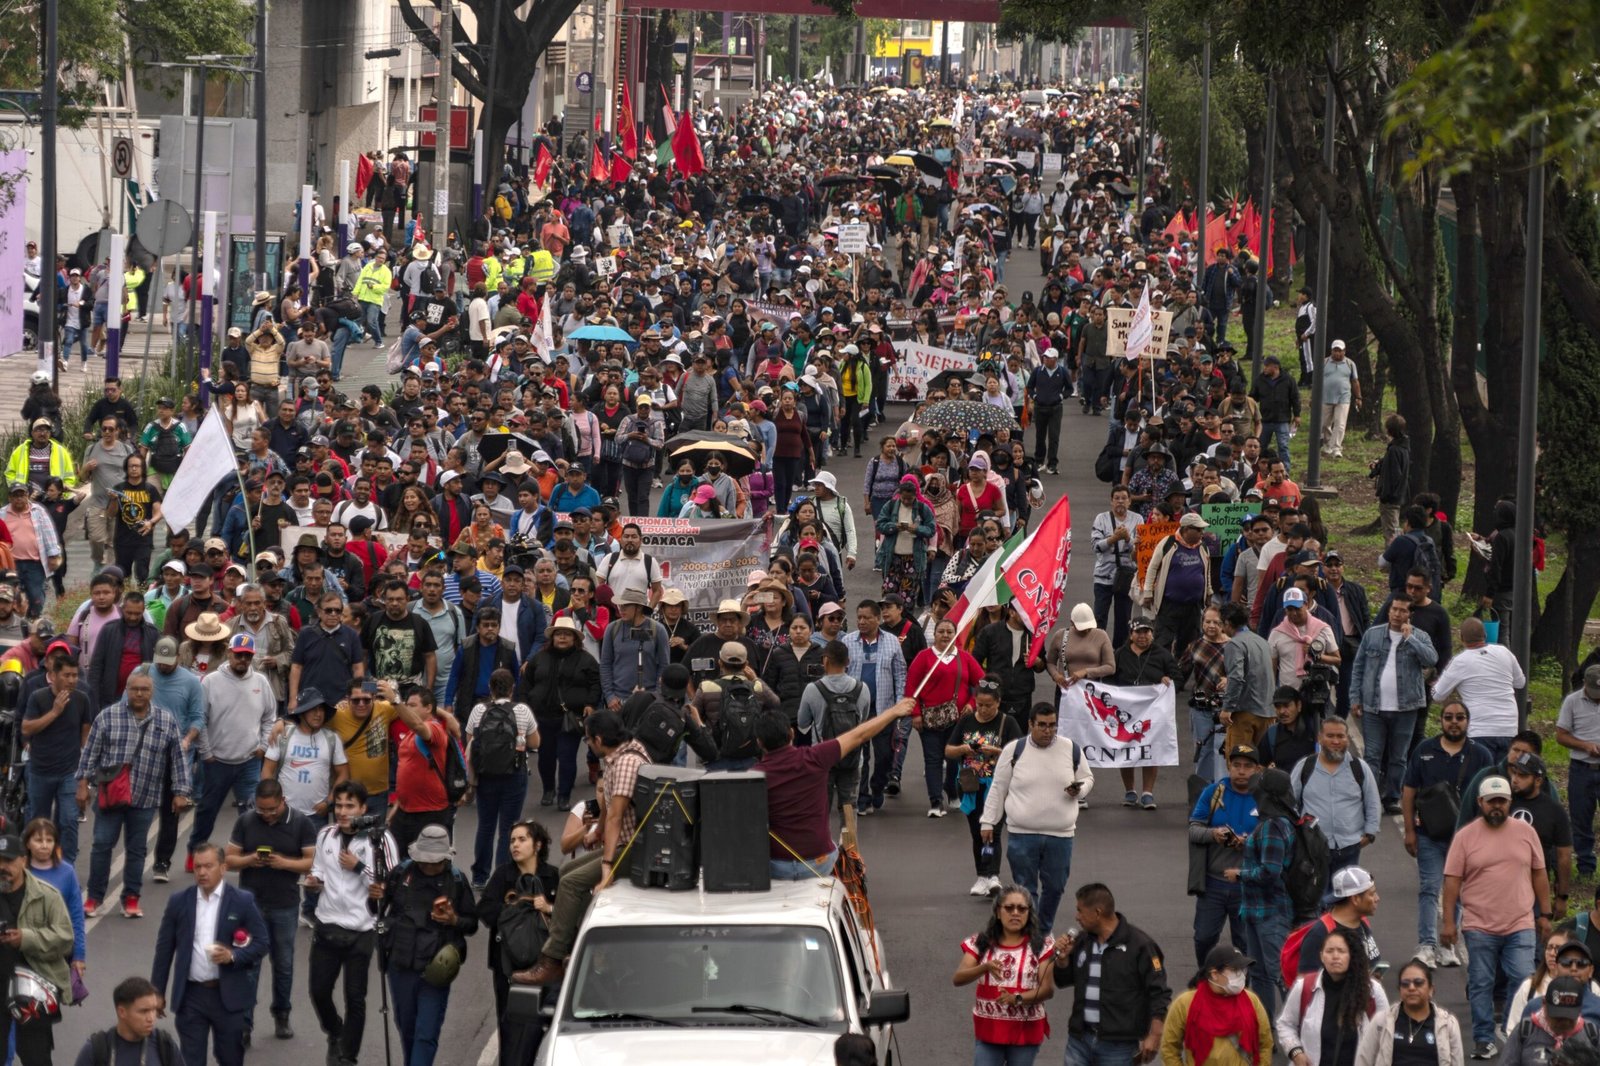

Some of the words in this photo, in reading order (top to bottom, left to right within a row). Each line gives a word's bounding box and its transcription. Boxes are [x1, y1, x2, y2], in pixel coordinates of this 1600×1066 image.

[1212, 505, 1221, 513] No
[1224, 504, 1249, 513] quiero
[622, 517, 673, 526] NACIONAL
[676, 518, 690, 527] DE
[642, 535, 695, 547] OAXACA
[697, 568, 753, 581] PERDONAMO
[700, 577, 748, 589] OLVIDAMO
[291, 745, 319, 758] JUST
[1083, 744, 1153, 763] CNTE
